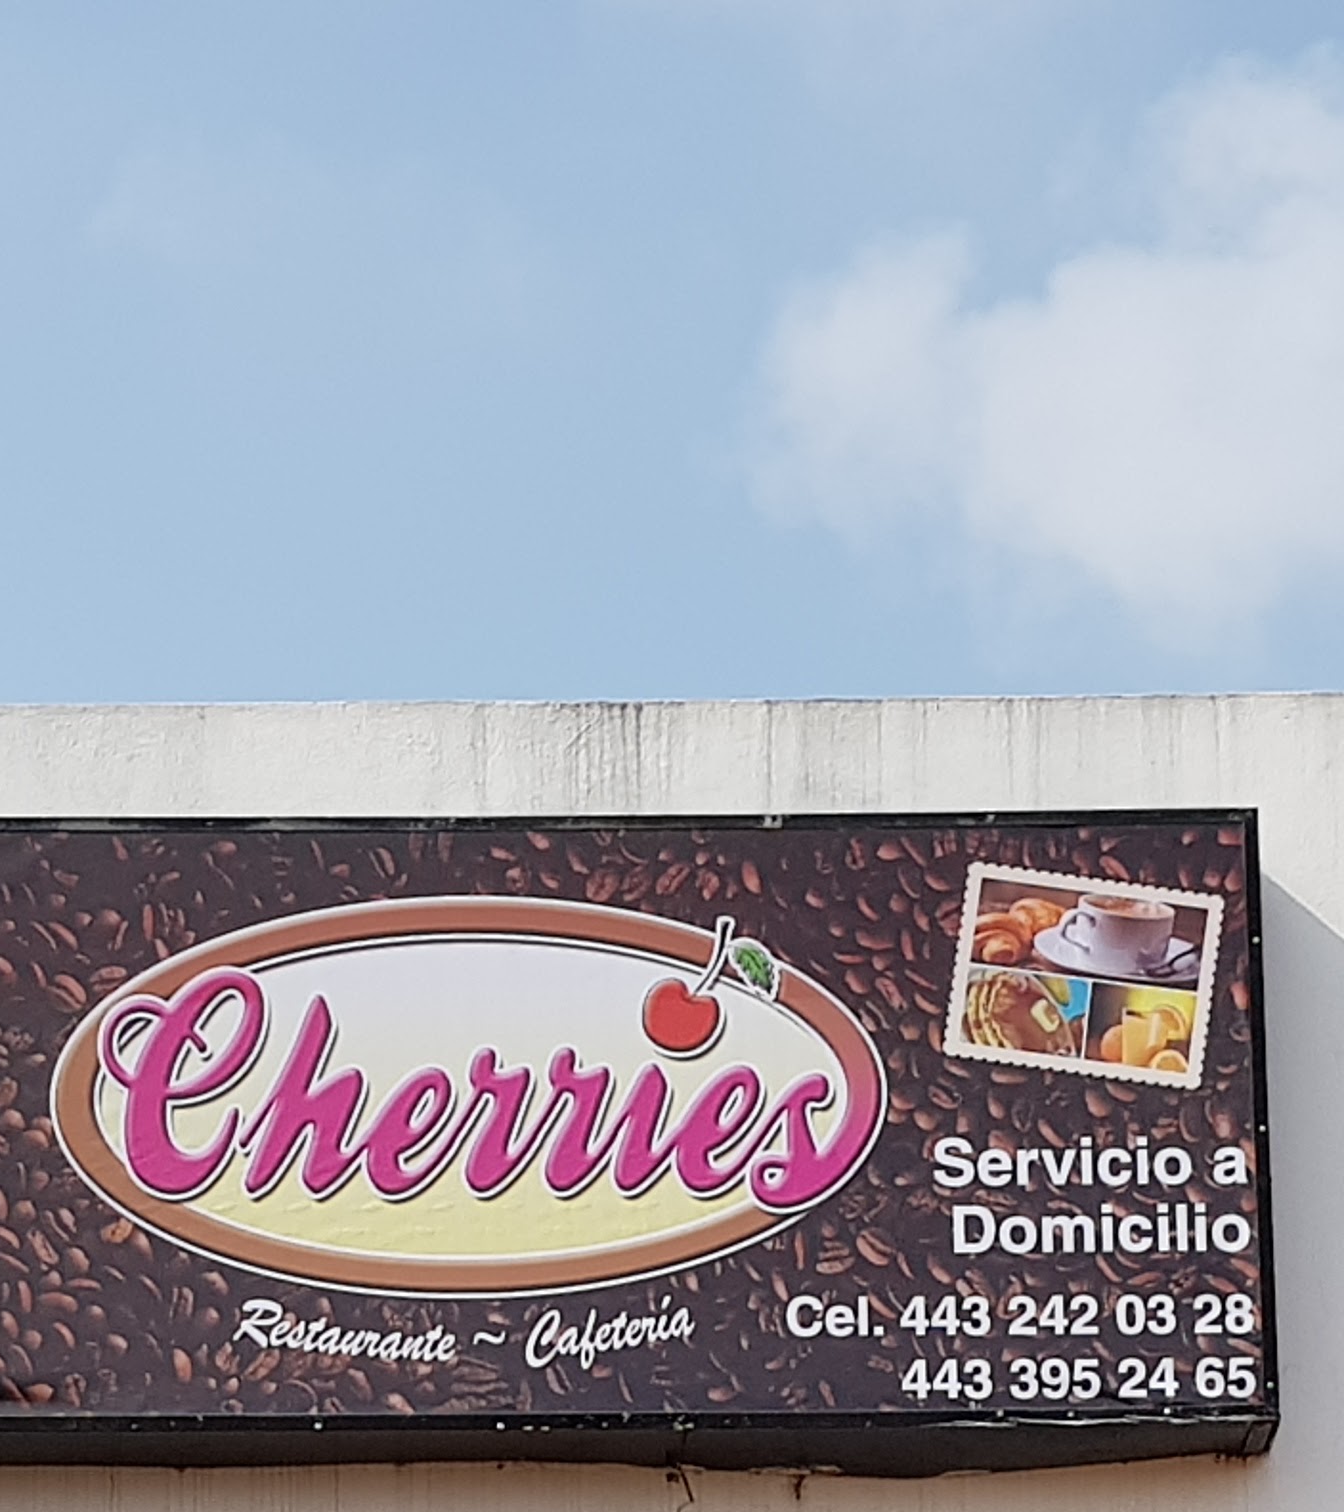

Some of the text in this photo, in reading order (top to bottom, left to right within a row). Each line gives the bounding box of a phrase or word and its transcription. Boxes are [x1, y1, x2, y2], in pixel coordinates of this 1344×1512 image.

[99, 966, 868, 1214] Cherries
[932, 1135, 1249, 1188] Servicio a
[952, 1202, 1252, 1255] Domicilio
[233, 1297, 456, 1362] Restaurante
[524, 1294, 696, 1370] Cafetería
[784, 1293, 1256, 1338] Cel. 443 242 03 28
[901, 1356, 1258, 1400] 443 395 24 65
